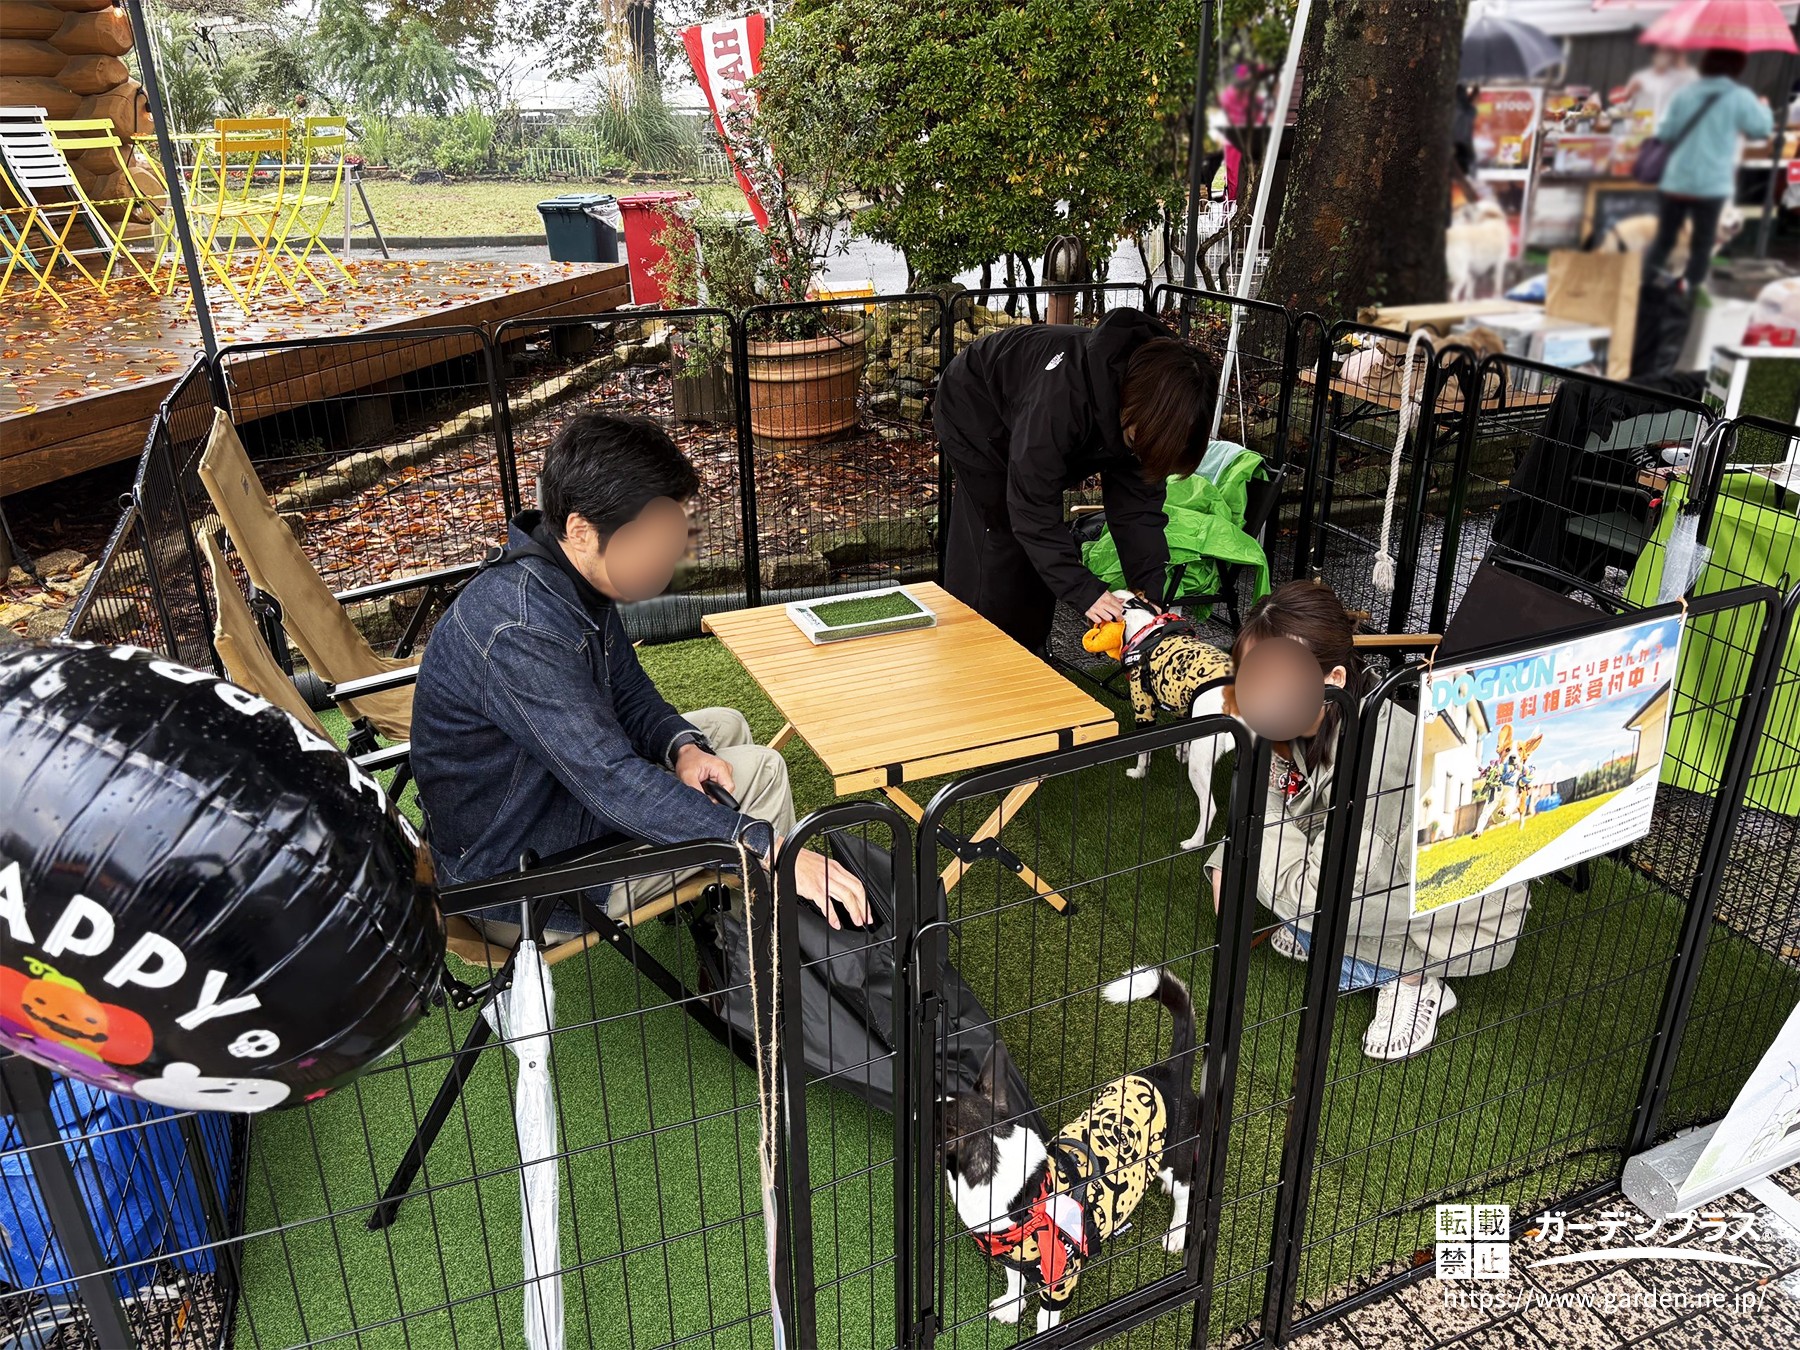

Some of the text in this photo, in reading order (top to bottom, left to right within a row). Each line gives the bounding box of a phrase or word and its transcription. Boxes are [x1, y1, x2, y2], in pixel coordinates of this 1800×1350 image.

[1495, 662, 1660, 725] 無料相談受付中！
